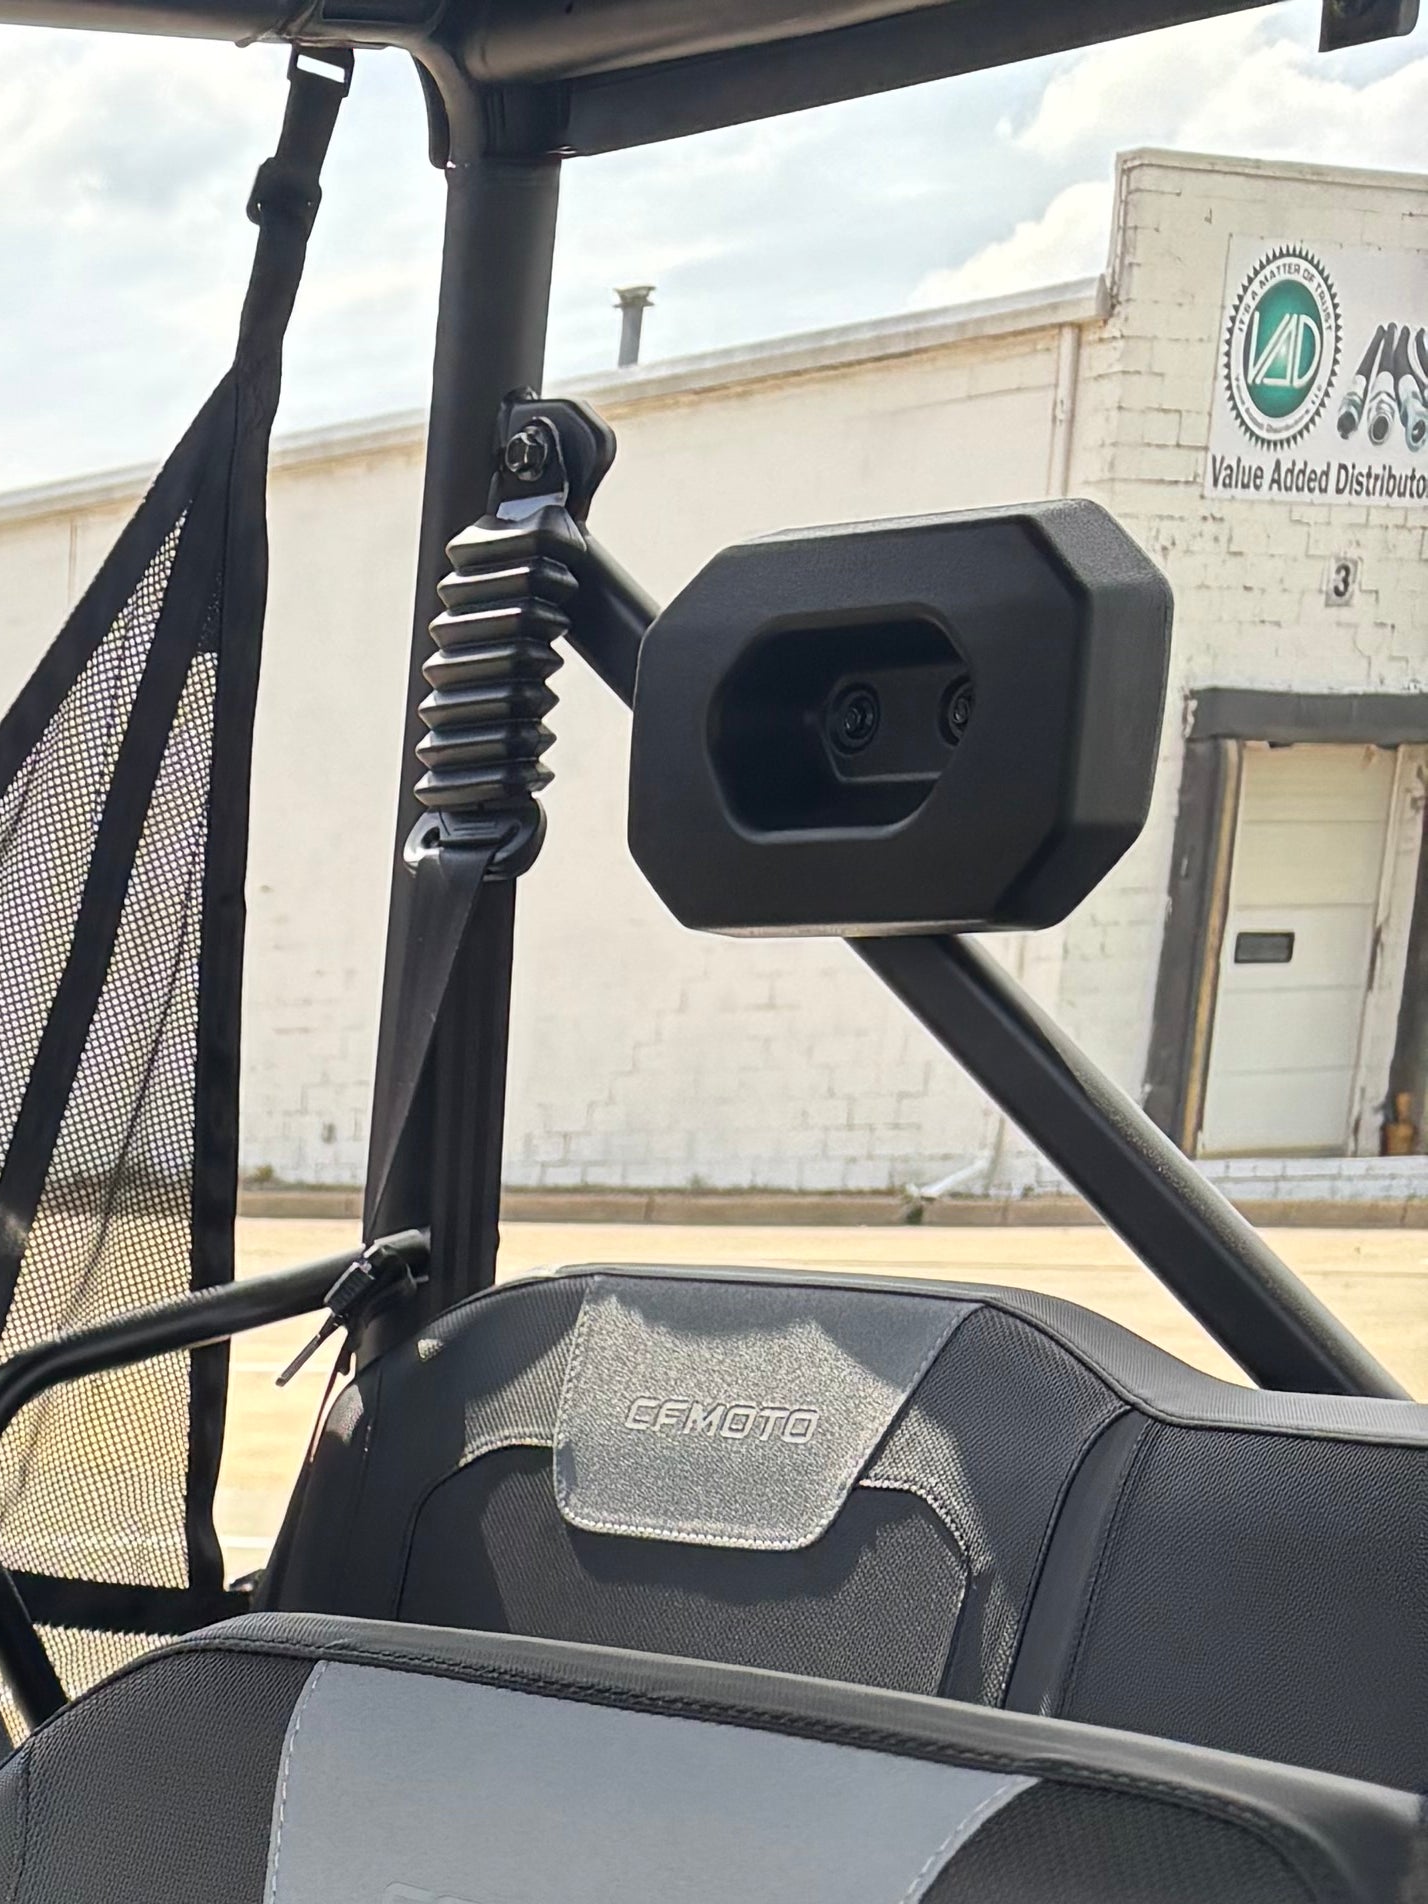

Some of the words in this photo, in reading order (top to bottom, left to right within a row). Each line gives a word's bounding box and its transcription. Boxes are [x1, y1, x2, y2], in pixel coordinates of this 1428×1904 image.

[1259, 262, 1301, 290] MATTER
[1302, 267, 1316, 283] OF
[1315, 281, 1333, 330] TRUST
[1247, 310, 1322, 389] VAD
[1211, 453, 1265, 491] Value
[1268, 457, 1332, 494] Added
[1334, 461, 1428, 499] Distributo
[1333, 562, 1352, 598] 3
[624, 1394, 821, 1444] CFMOTO
